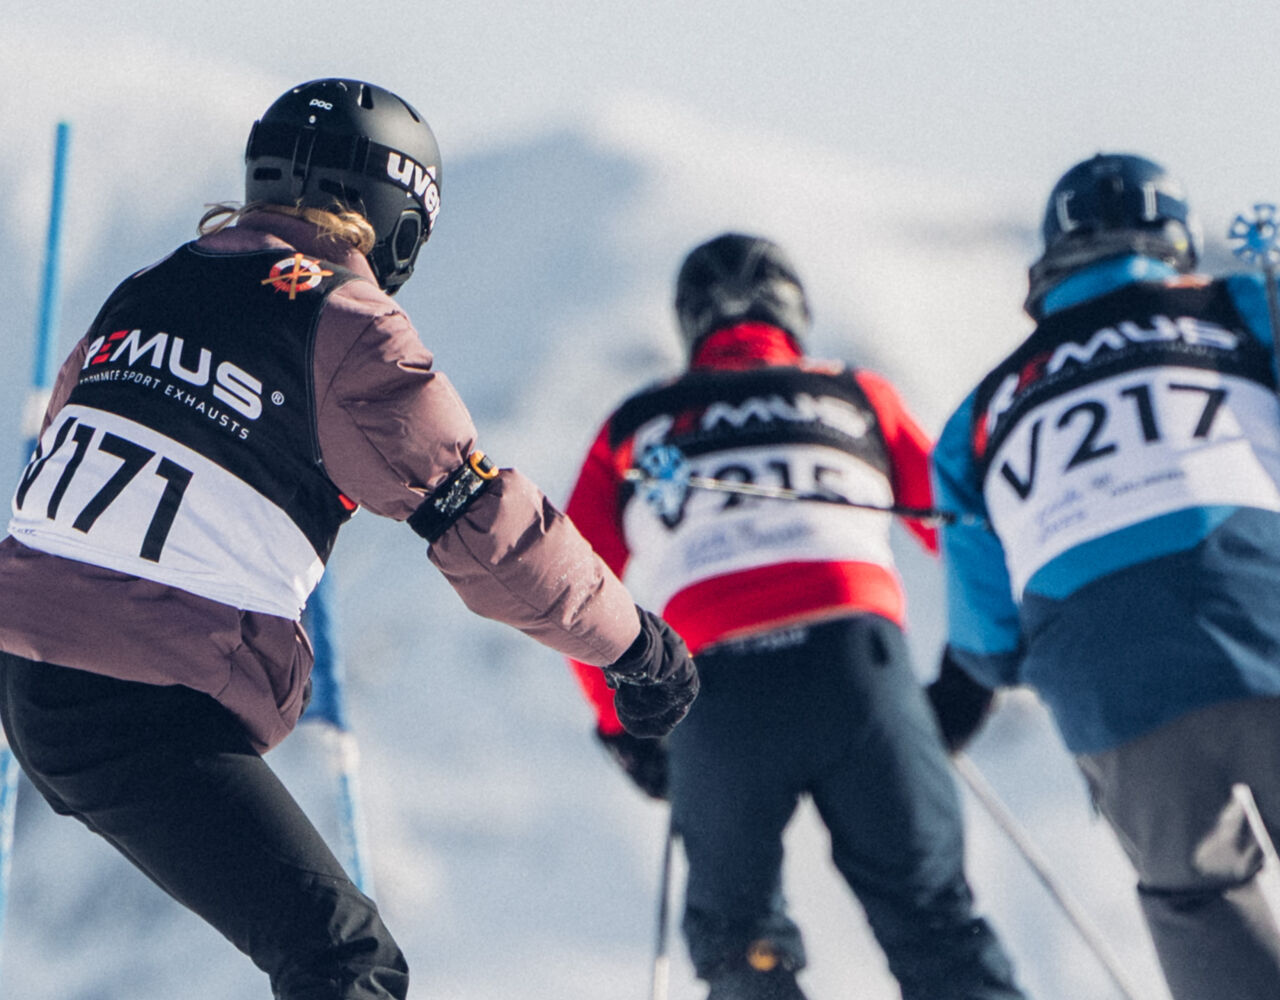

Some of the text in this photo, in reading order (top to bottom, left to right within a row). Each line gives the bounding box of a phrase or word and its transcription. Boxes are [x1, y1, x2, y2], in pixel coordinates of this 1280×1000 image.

[309, 98, 333, 110] poc
[81, 329, 263, 420] REMUS
[122, 370, 161, 389] SPORT
[164, 384, 250, 440] EXHAUSTS
[1001, 384, 1227, 500] V217
[16, 416, 194, 563] V171
